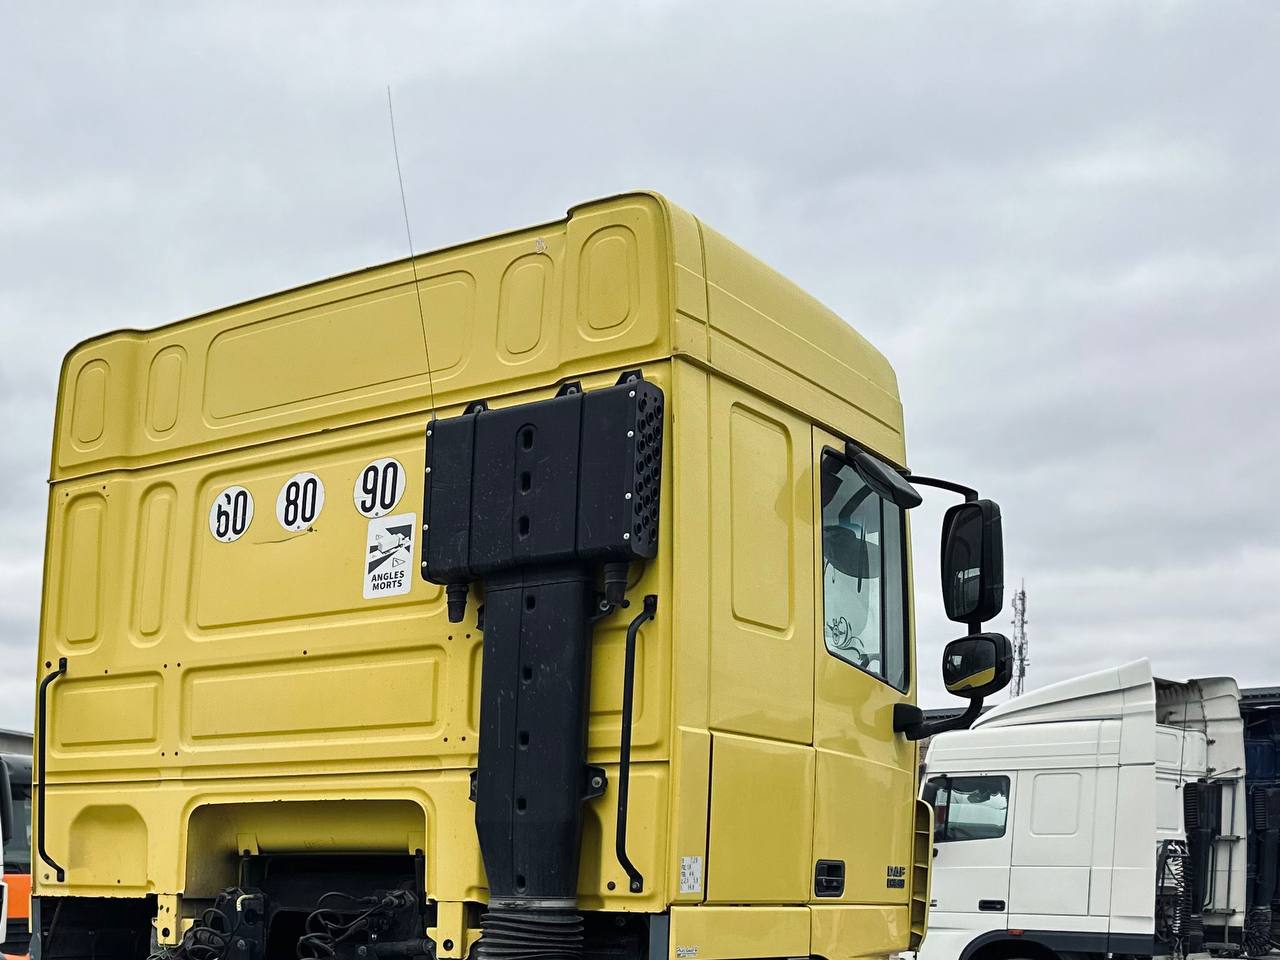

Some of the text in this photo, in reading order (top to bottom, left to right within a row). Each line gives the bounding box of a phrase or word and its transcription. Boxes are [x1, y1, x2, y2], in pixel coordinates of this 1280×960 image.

[284, 477, 318, 527] 80
[361, 462, 398, 513] 90
[216, 490, 248, 538] 60
[371, 570, 405, 583] ANGLES
[372, 579, 403, 591] MORTS
